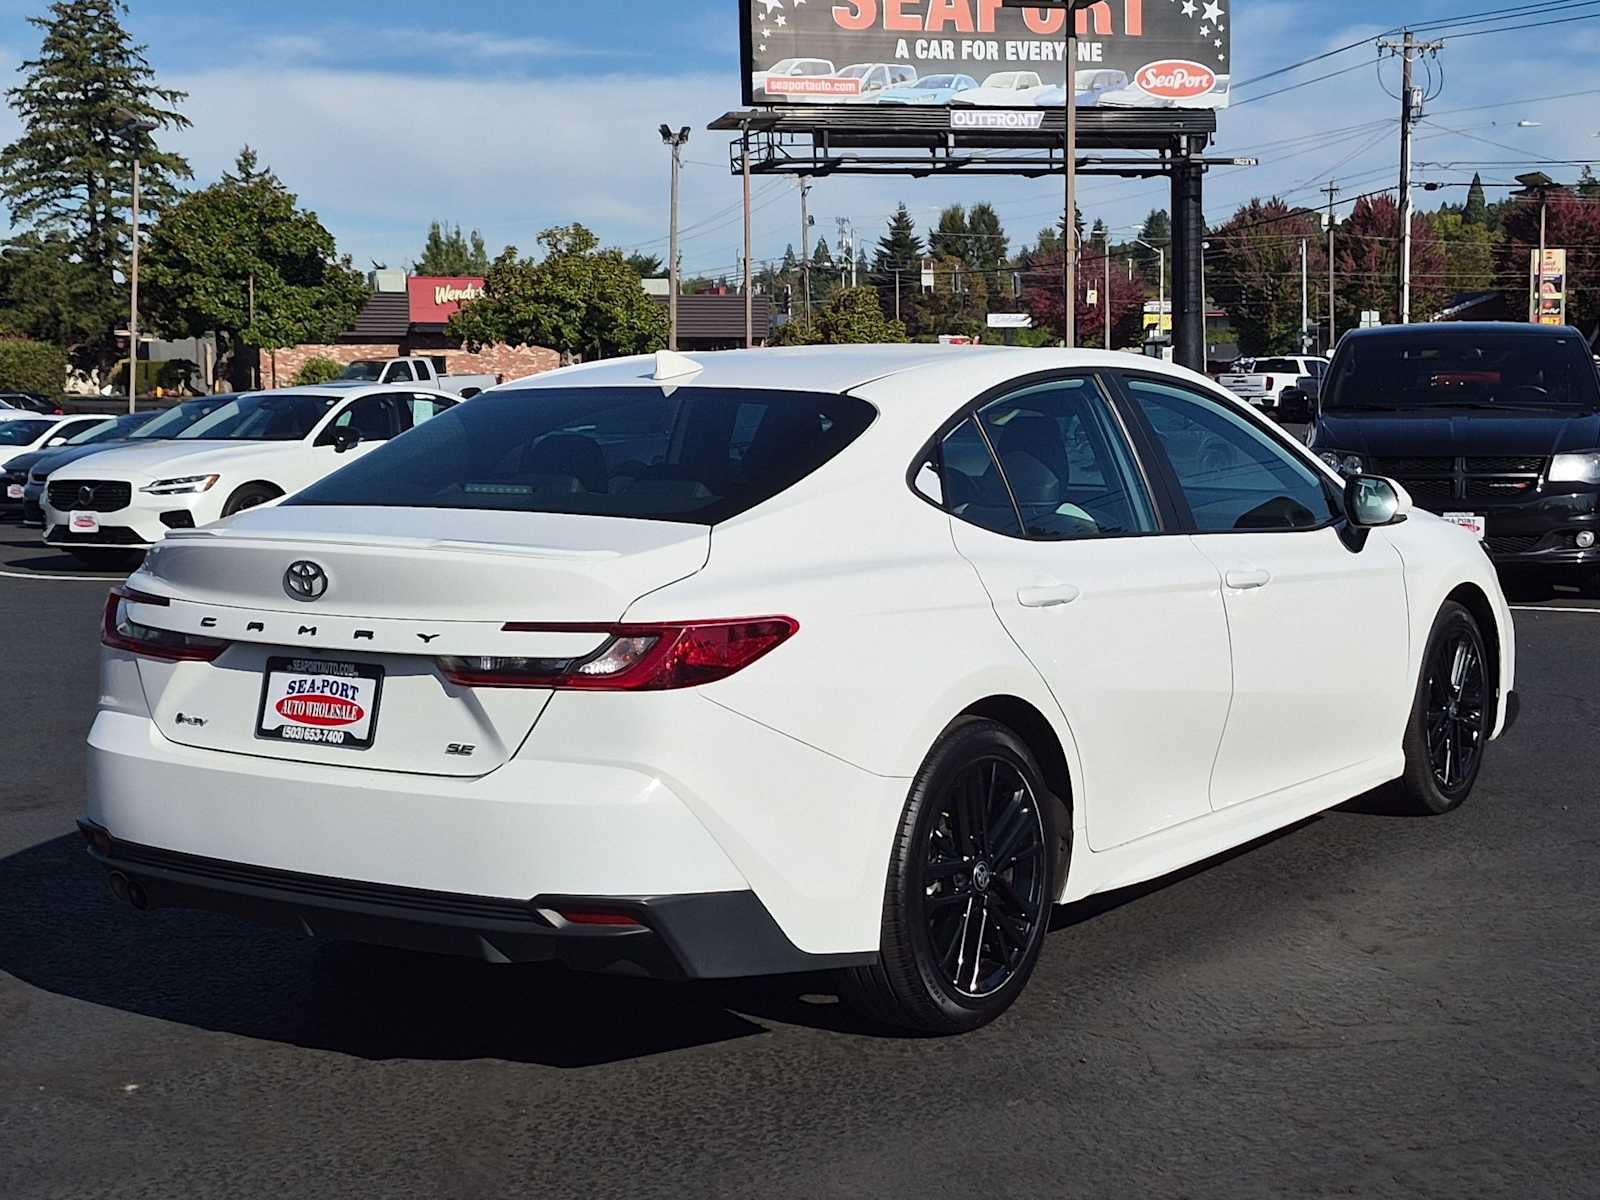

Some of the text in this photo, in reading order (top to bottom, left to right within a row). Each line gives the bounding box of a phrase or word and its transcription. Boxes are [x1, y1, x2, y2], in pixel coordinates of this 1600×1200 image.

[895, 39, 1103, 62] A CAR FOR EVERYNE
[770, 80, 857, 93] seaportauto.com
[1141, 68, 1210, 90] SeaPort
[954, 111, 1040, 127] OUTFRONT
[200, 617, 440, 643] CAMRY
[287, 679, 359, 701] SEA-PORT
[281, 700, 358, 720] AUTO WHOLESALE
[445, 743, 476, 756] SE
